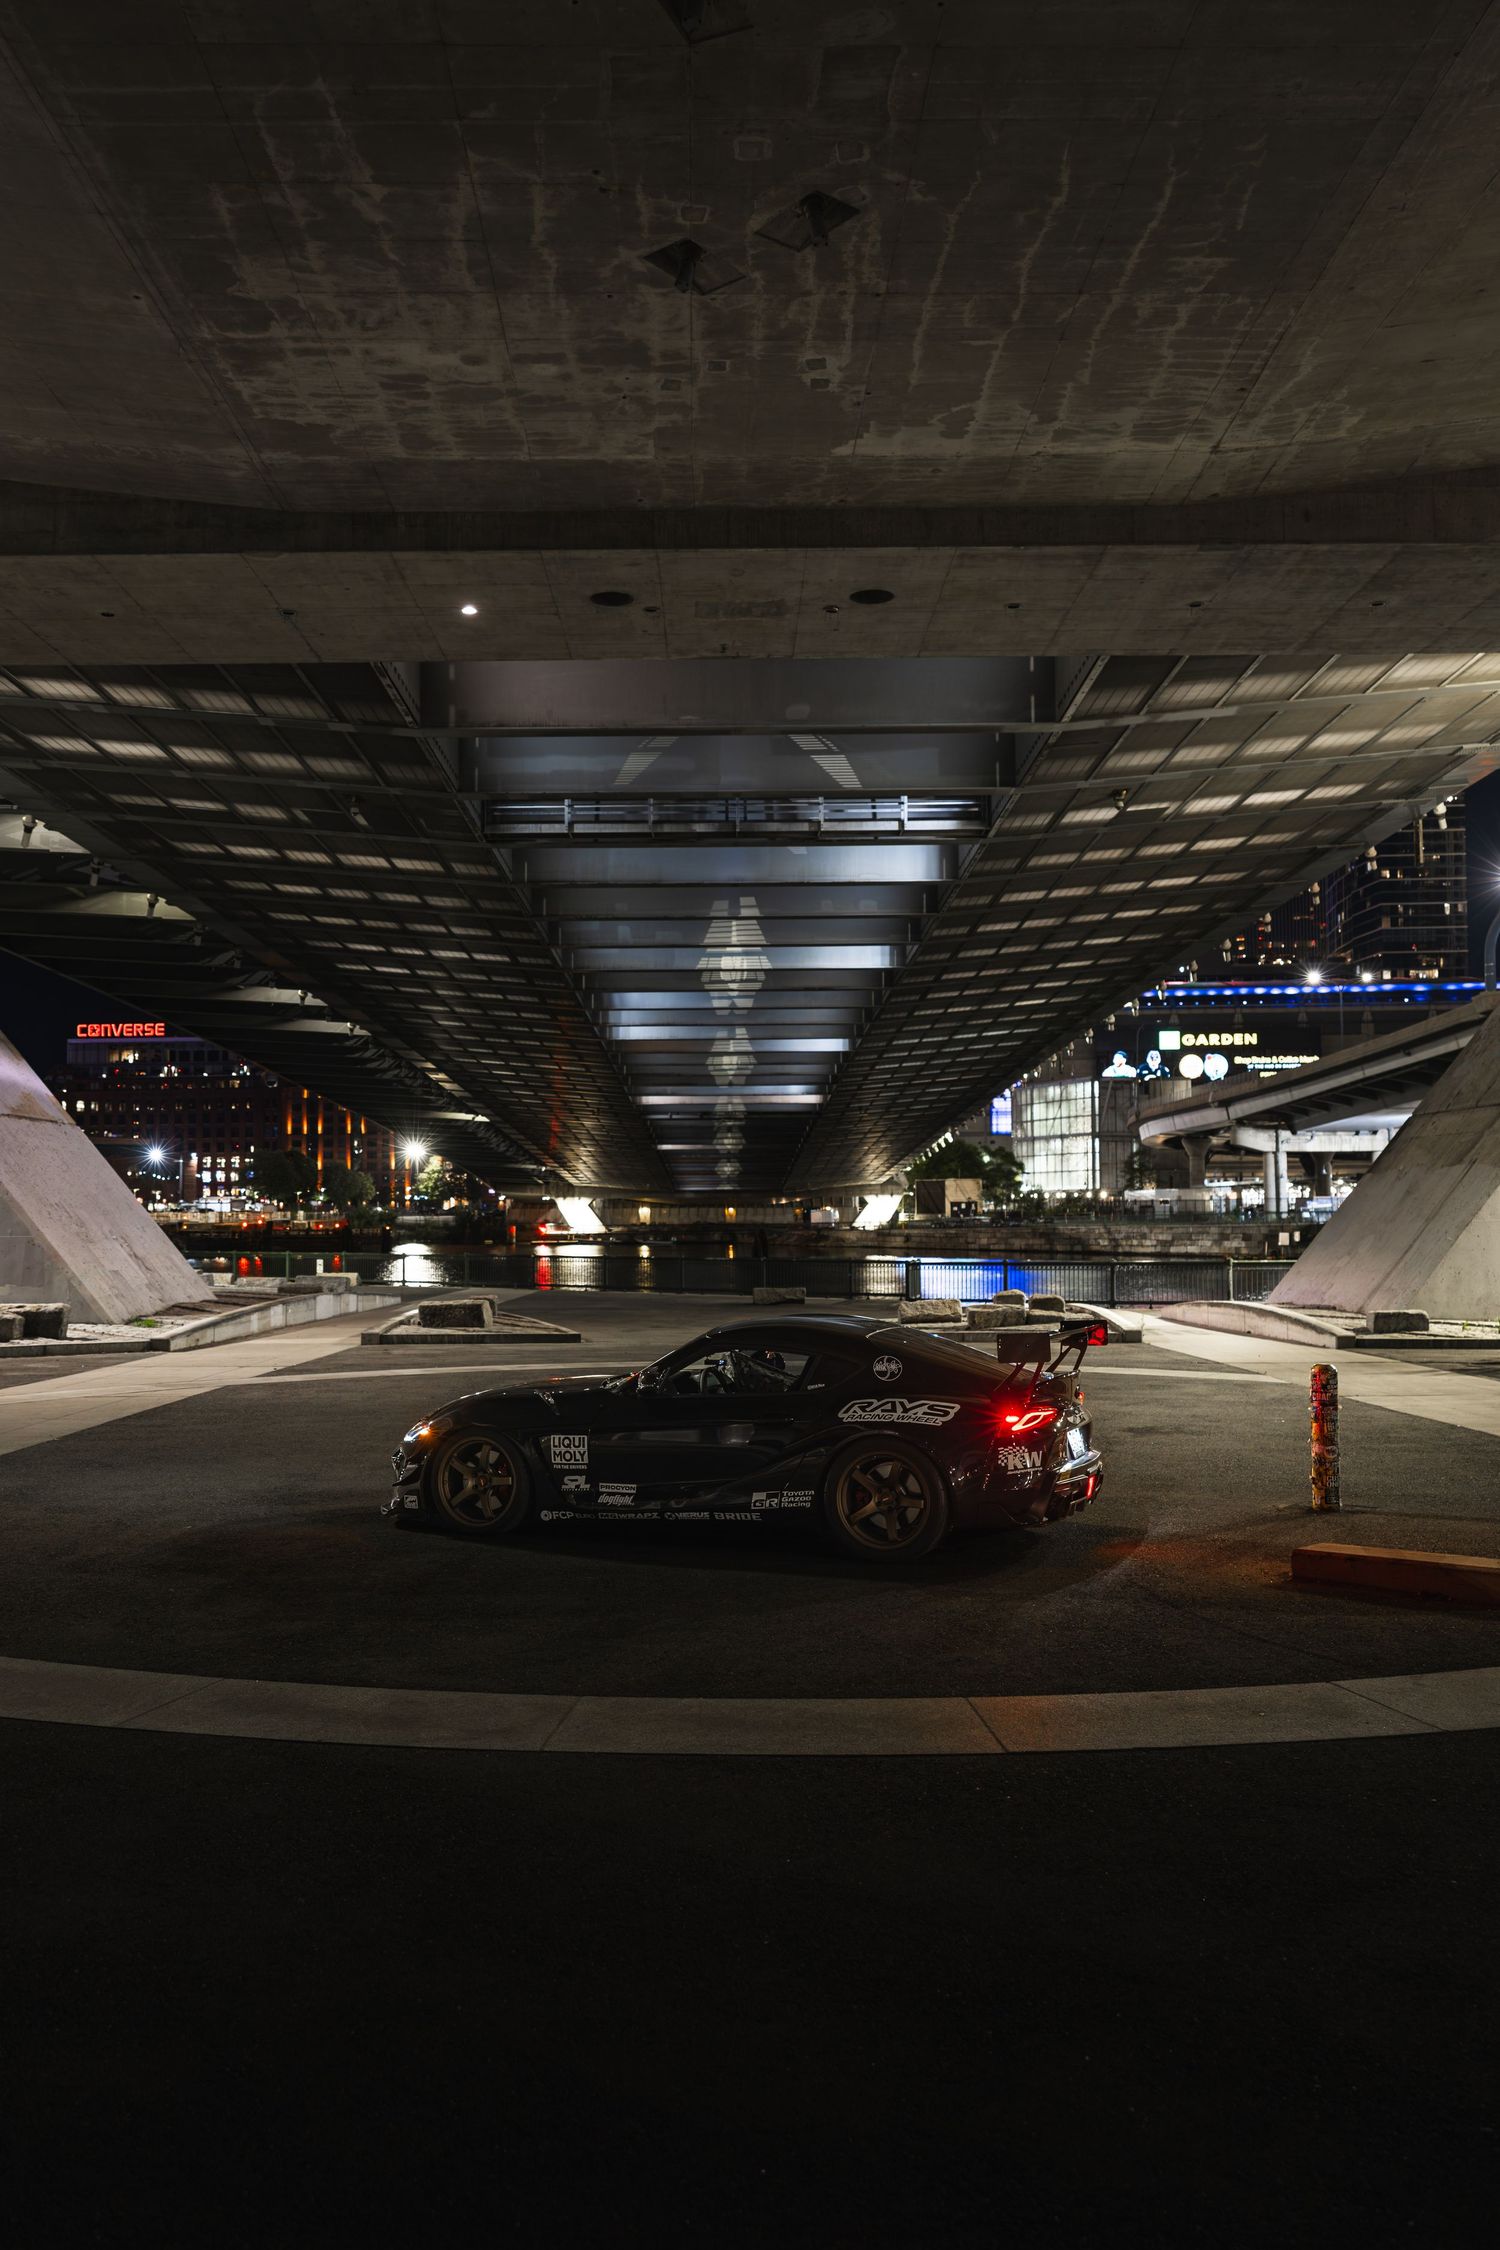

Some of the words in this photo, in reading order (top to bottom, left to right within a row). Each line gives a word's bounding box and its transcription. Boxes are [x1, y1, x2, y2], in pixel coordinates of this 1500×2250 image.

[76, 1023, 165, 1037] CONVERSE
[1181, 1033, 1258, 1046] GARDEN
[844, 1400, 957, 1418] RAYS
[846, 1413, 892, 1421] RACING
[896, 1413, 940, 1424] WHEEL
[552, 1436, 586, 1449] LIQUI
[553, 1450, 587, 1462] MOLY
[1007, 1450, 1043, 1470] KW
[600, 1484, 636, 1492] PROCYON
[781, 1501, 811, 1509] Racing
[551, 1511, 574, 1519] FCP
[713, 1512, 763, 1520] BRIDE
